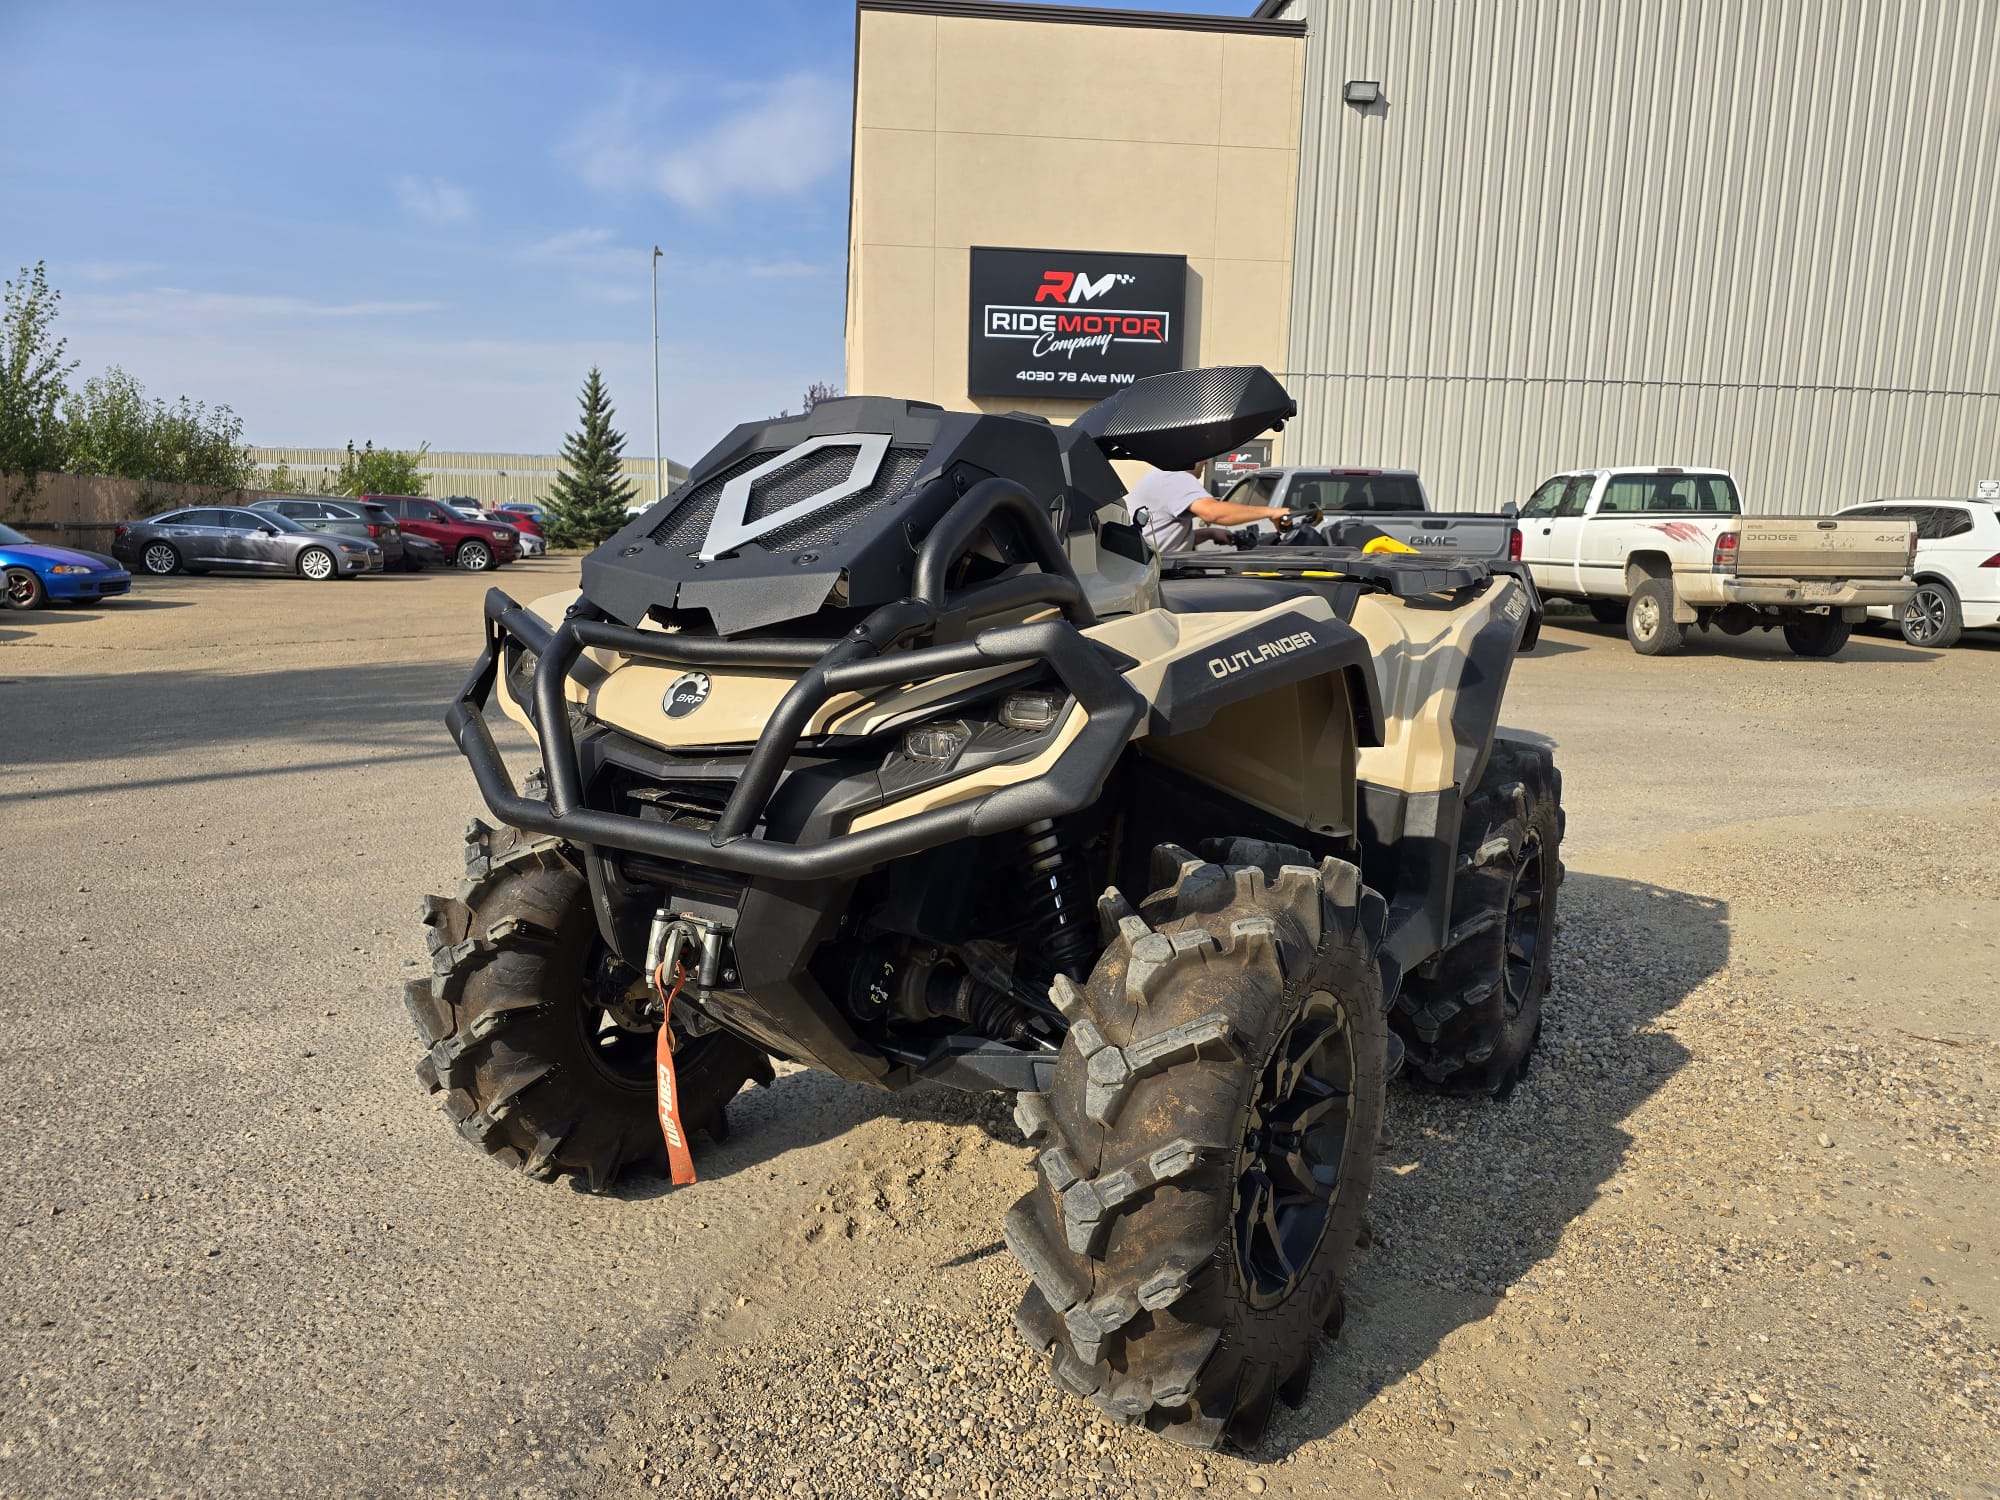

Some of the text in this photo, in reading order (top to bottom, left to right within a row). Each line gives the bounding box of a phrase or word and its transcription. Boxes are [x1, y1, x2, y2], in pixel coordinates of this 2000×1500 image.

[1034, 270, 1117, 303] RM
[992, 312, 1167, 344] RIDEMOTOR
[1032, 331, 1113, 359] Company
[1016, 371, 1135, 384] 4030 78 Ave NW
[1409, 535, 1458, 546] GMC
[1208, 631, 1317, 679] OUTLANDER
[676, 693, 703, 704] BRP
[659, 1063, 682, 1149] can-am
